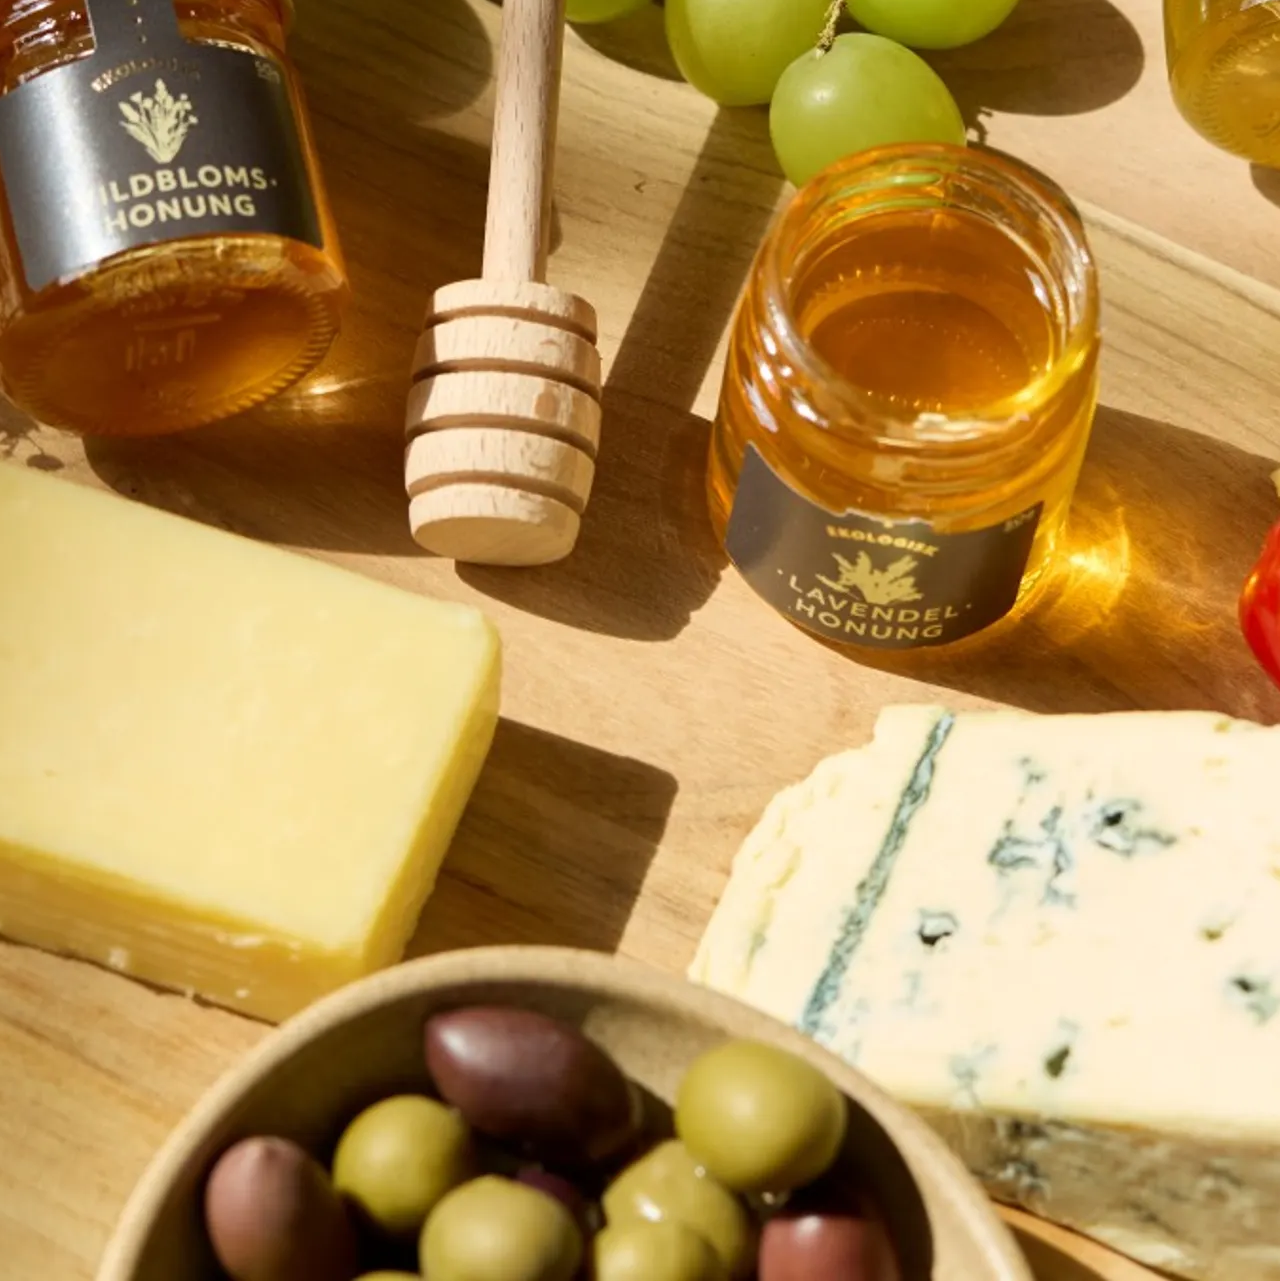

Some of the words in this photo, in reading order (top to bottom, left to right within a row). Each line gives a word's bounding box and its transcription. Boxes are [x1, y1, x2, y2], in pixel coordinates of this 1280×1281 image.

[82, 164, 268, 207] ILDBLOMS
[104, 194, 257, 234] HONUNG
[788, 574, 960, 623] LAVENDEL
[794, 598, 944, 640] HONUNG
